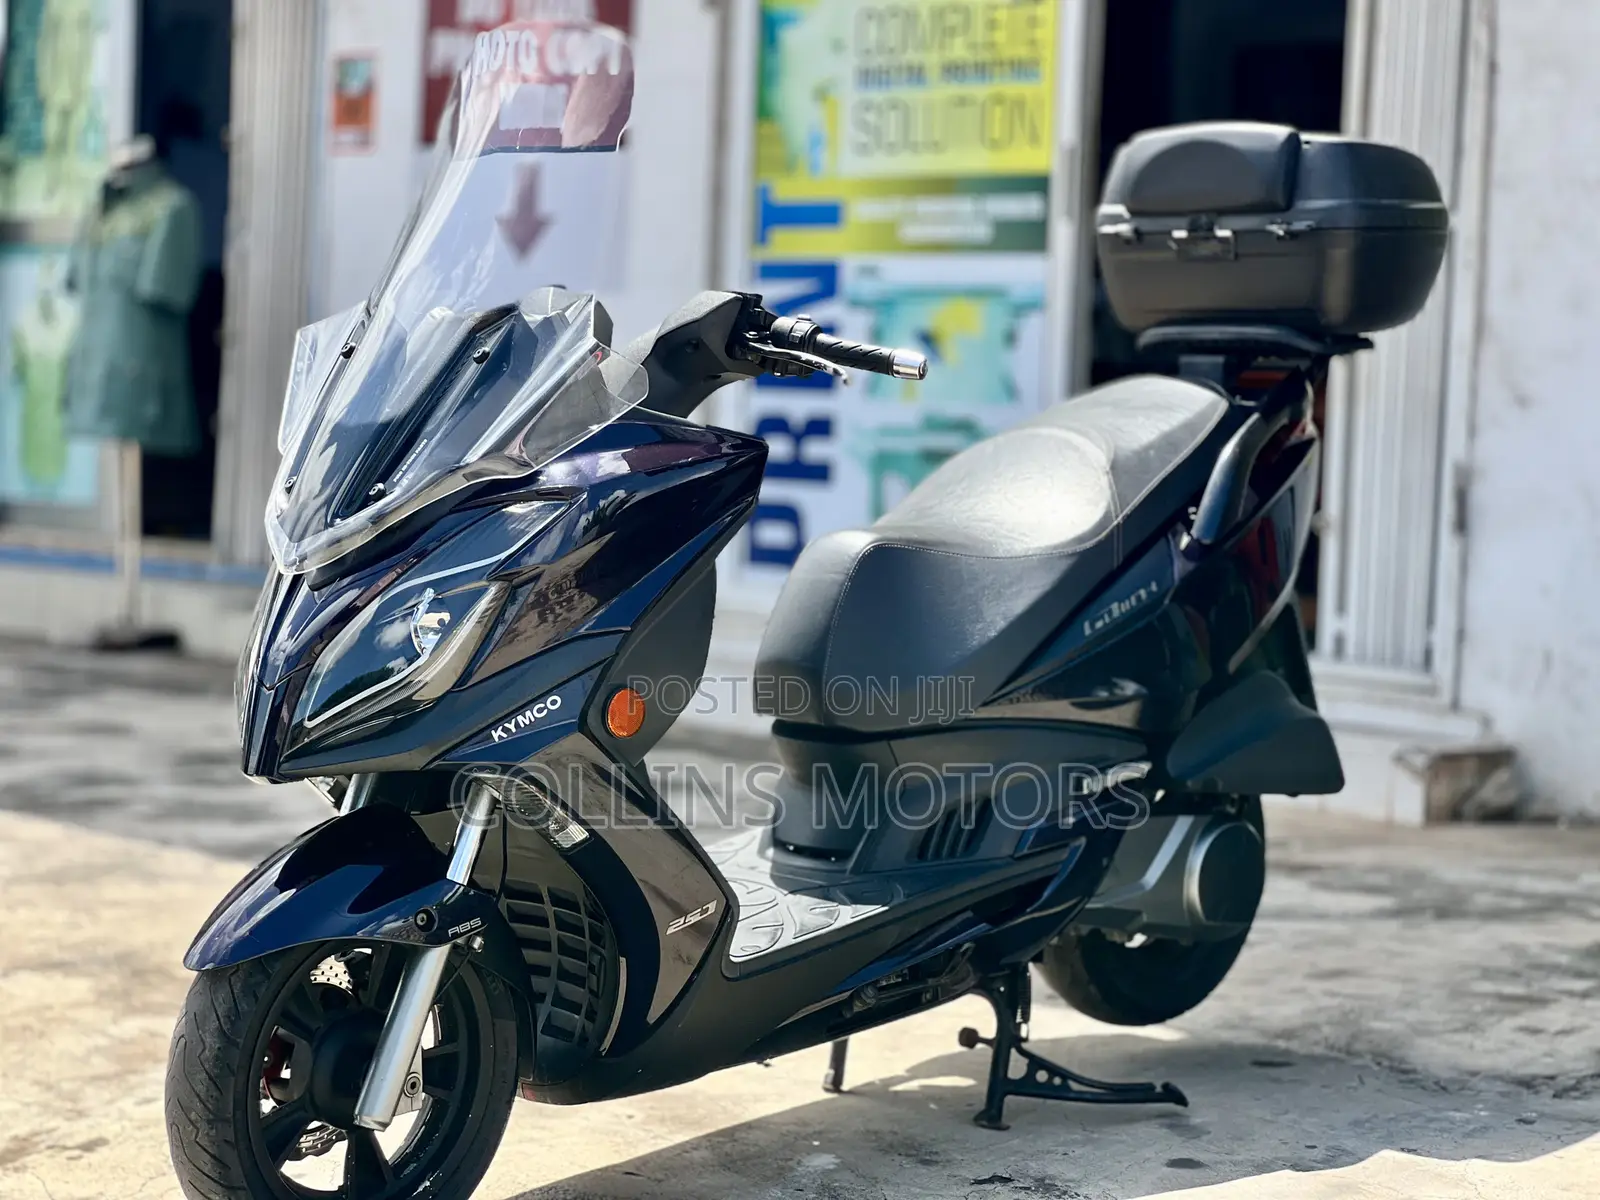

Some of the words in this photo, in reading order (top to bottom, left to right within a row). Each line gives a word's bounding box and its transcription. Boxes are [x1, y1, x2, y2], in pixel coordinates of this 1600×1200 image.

[852, 3, 1044, 58] COMPLETE
[850, 93, 1043, 157] SOLUTION
[490, 694, 563, 743] KYMCO
[447, 917, 482, 938] ABS
